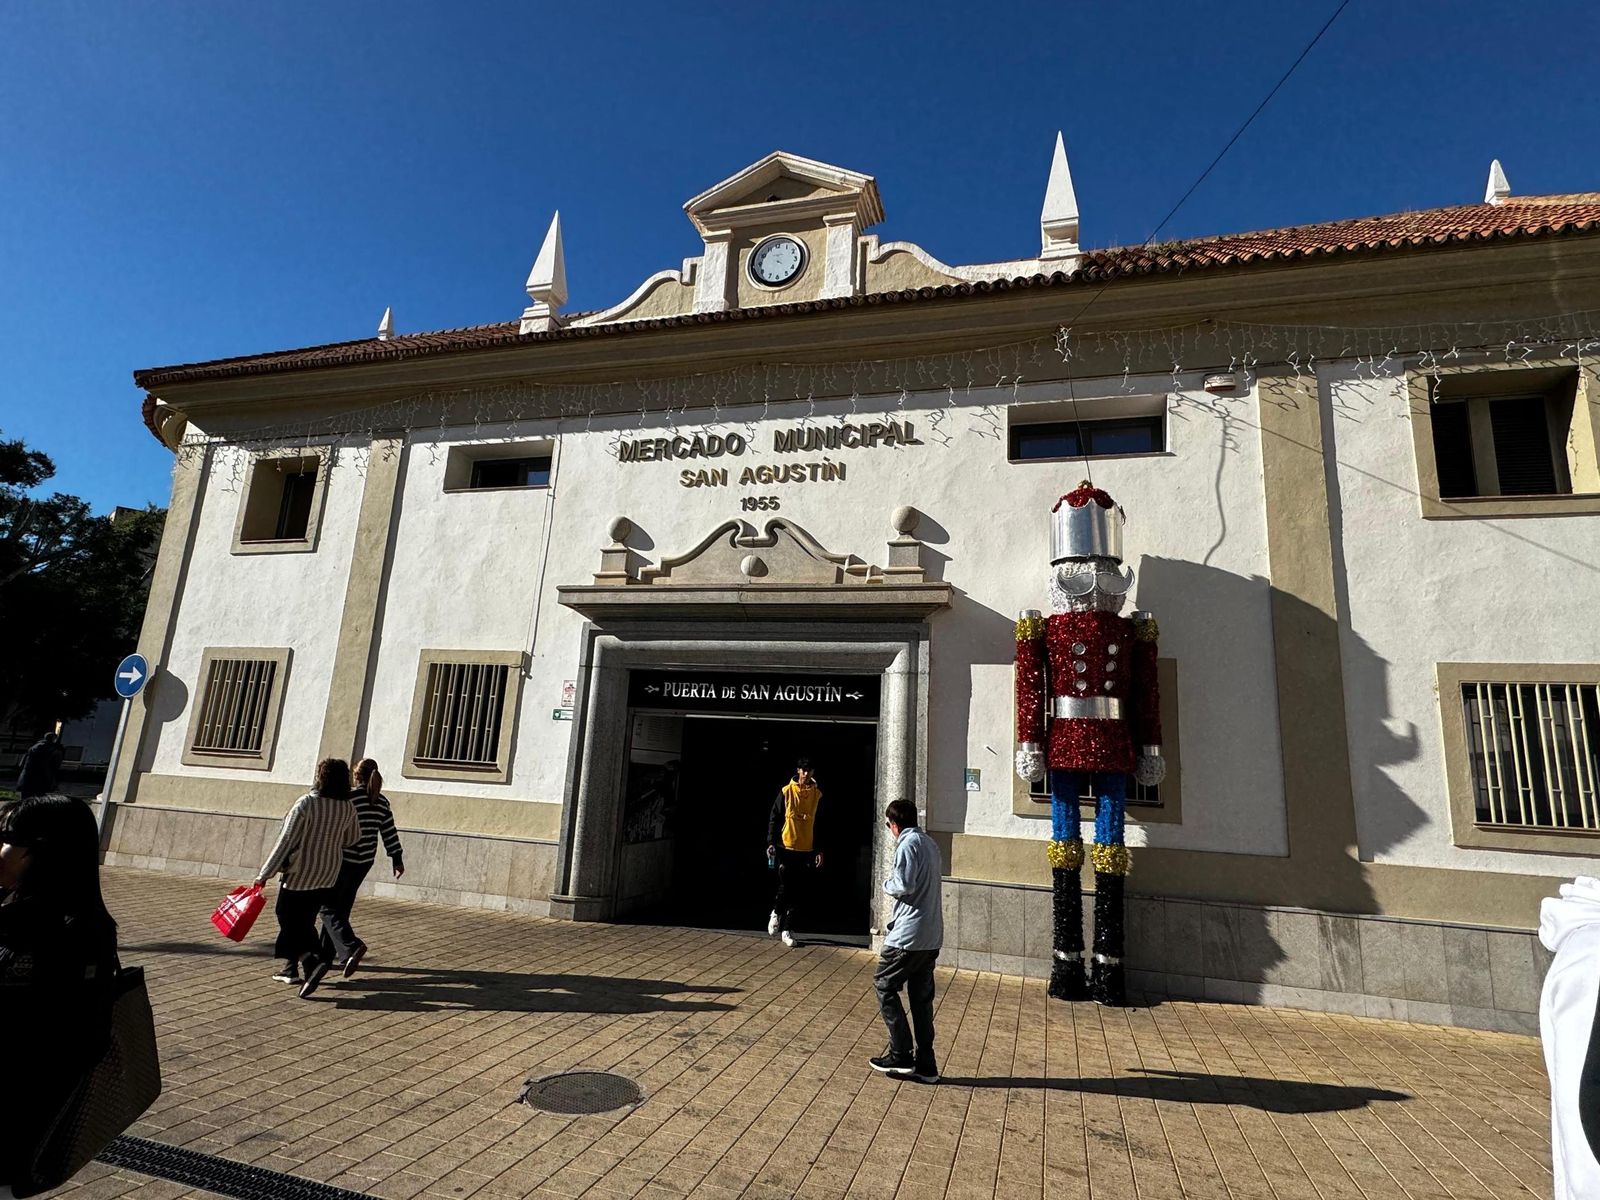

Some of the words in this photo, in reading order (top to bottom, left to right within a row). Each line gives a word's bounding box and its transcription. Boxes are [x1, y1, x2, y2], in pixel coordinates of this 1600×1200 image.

[618, 431, 746, 463] MERCADO
[773, 420, 924, 454] MUNICIPAL
[679, 467, 728, 488] SAN
[740, 495, 781, 512] 1955
[663, 681, 716, 699] PUERTA
[721, 685, 737, 699] DE
[740, 683, 770, 701] SAN
[773, 682, 843, 702] AGUSTÍN
